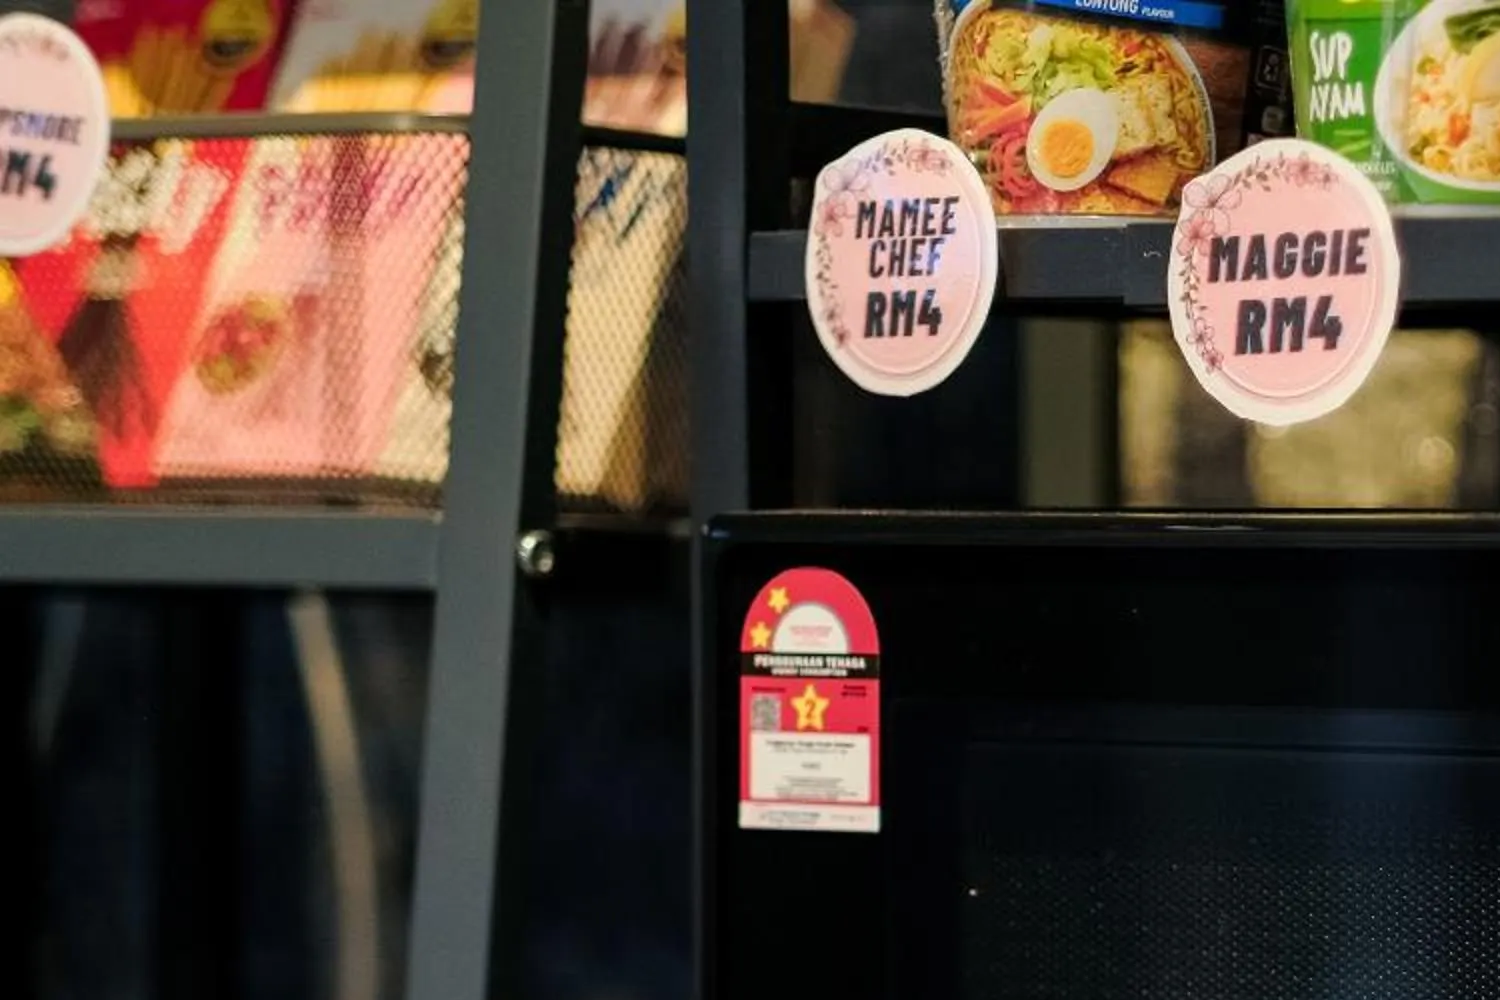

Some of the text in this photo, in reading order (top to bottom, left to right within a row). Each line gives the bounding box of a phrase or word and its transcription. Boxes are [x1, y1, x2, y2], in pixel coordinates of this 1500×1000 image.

[1309, 29, 1353, 82] SUP
[1309, 81, 1366, 123] AYAM
[855, 196, 960, 239] MAMEE
[869, 237, 945, 278] CHEF
[1207, 228, 1371, 283] MAGGIE
[864, 288, 943, 338] RM4
[1234, 294, 1344, 356] RM4
